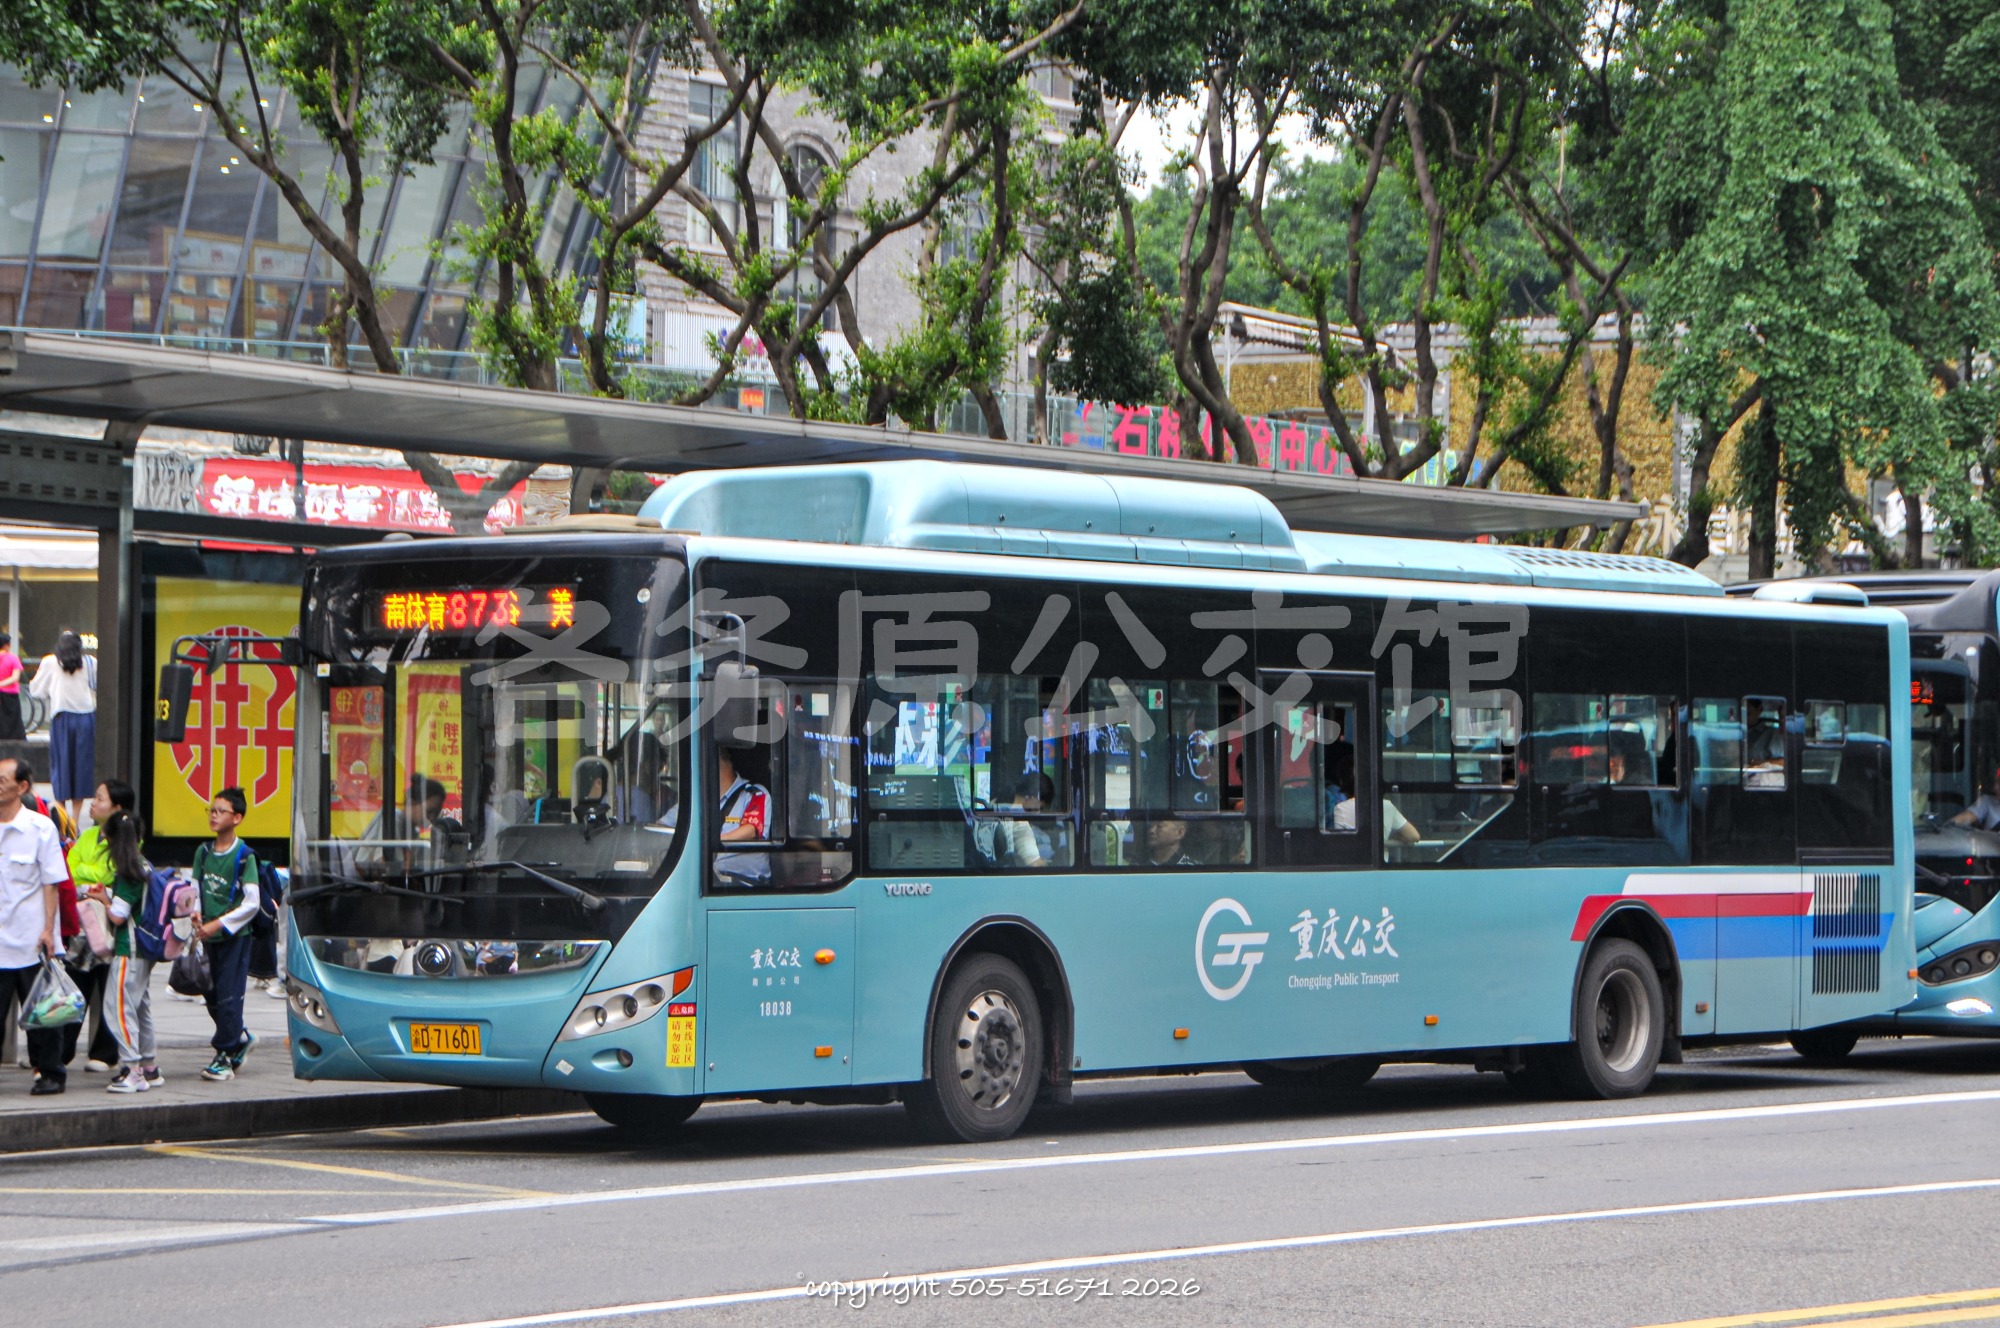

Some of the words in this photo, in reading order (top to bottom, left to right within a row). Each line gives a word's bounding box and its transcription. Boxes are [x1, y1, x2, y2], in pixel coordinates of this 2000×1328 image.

[450, 591, 509, 628] 873
[884, 882, 934, 897] YUTONG
[1289, 906, 1399, 962] 重庆公交
[750, 947, 802, 970] 重庆公交
[1288, 974, 1332, 990] Chongqing
[1333, 973, 1358, 986] Public
[1361, 972, 1400, 987] Transport
[760, 1001, 792, 1017] 18038
